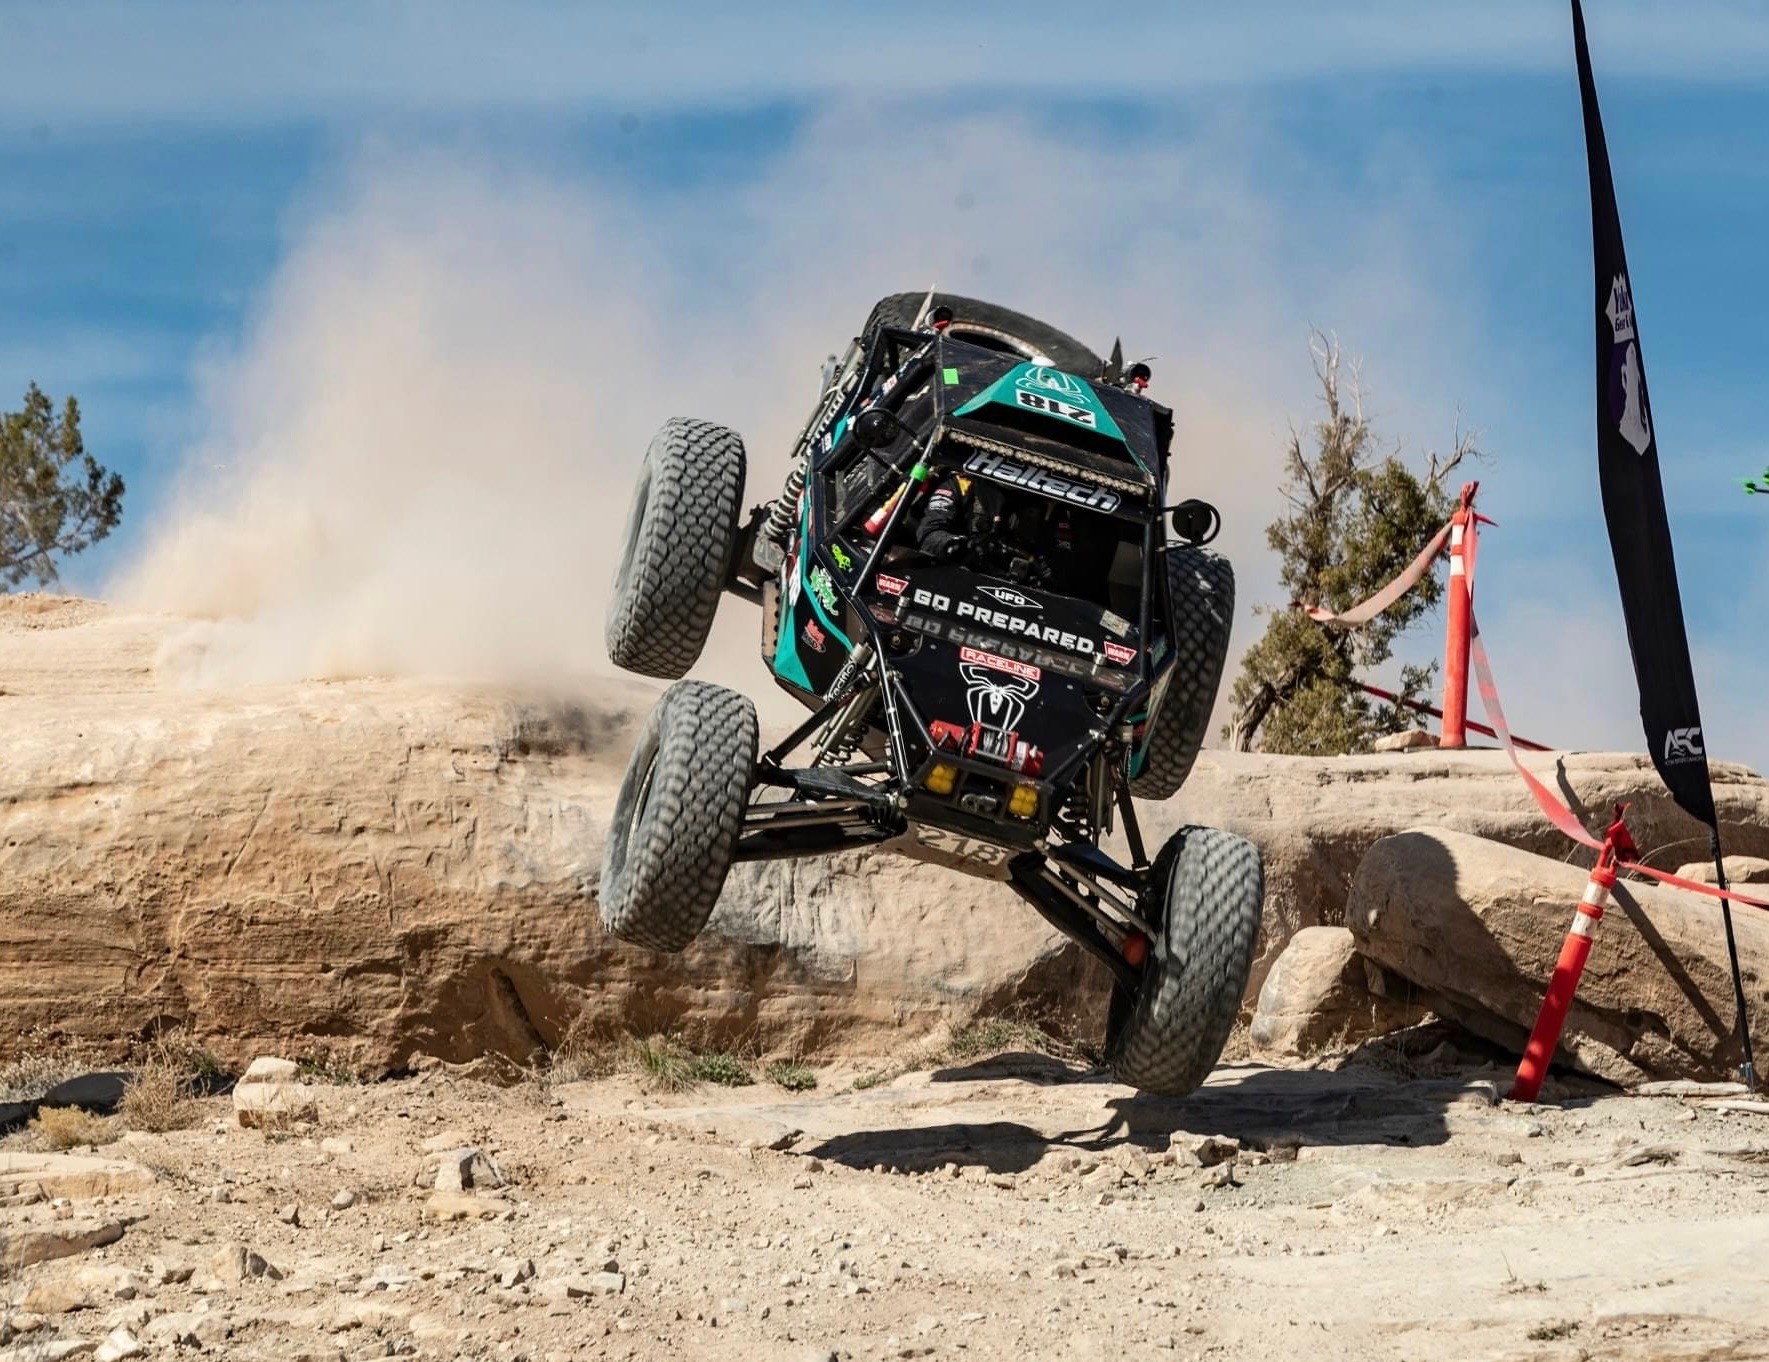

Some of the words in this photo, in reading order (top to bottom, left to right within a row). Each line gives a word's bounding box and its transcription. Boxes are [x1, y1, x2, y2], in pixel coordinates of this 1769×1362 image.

[1019, 392, 1093, 425] 218
[967, 449, 1118, 512] Haltech
[913, 588, 951, 612] GO
[994, 589, 1026, 606] UFO
[966, 649, 1036, 678] RACELINE
[1664, 727, 1703, 760] ASC
[917, 824, 1000, 863] 218
